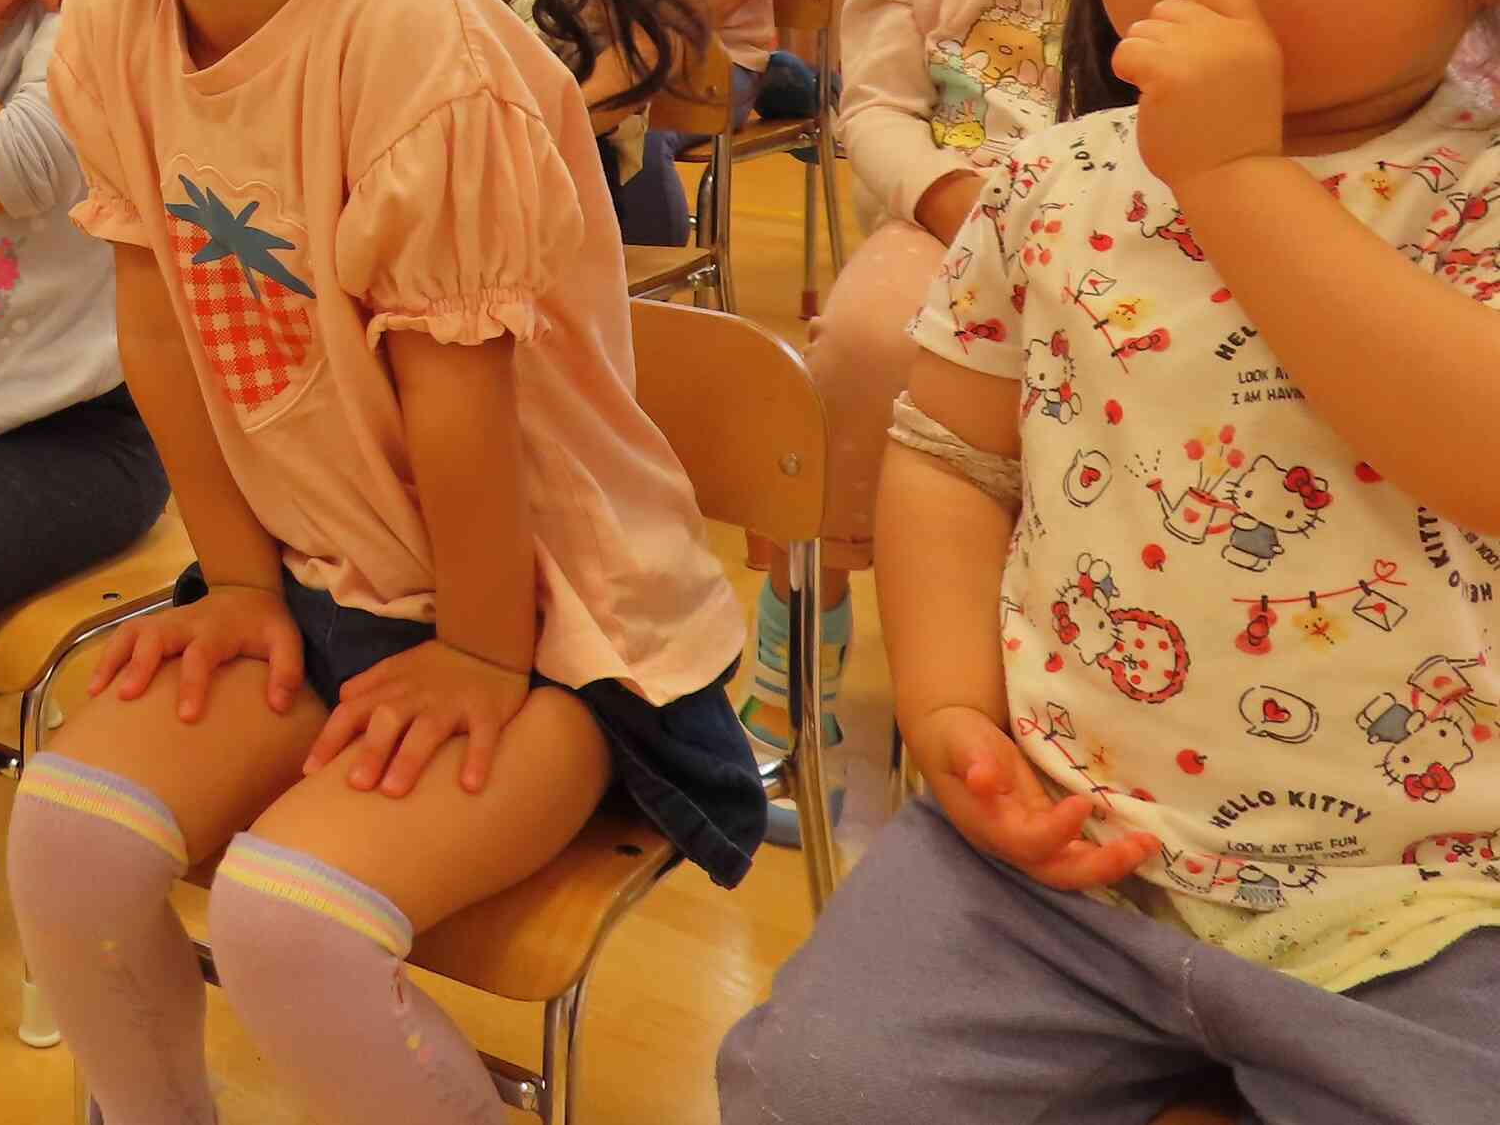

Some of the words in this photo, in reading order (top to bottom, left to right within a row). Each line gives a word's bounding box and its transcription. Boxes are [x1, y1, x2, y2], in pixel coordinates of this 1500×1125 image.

[1238, 369, 1269, 384] LOOK
[1275, 366, 1290, 380] A
[1232, 393, 1240, 406] I
[1244, 390, 1261, 403] AM
[1209, 790, 1276, 829] HELLO
[1288, 790, 1372, 824] KITTY
[1227, 841, 1264, 854] LOOK
[1271, 843, 1287, 854] AT
[1296, 840, 1324, 853] THE
[1330, 835, 1358, 849] FUN
